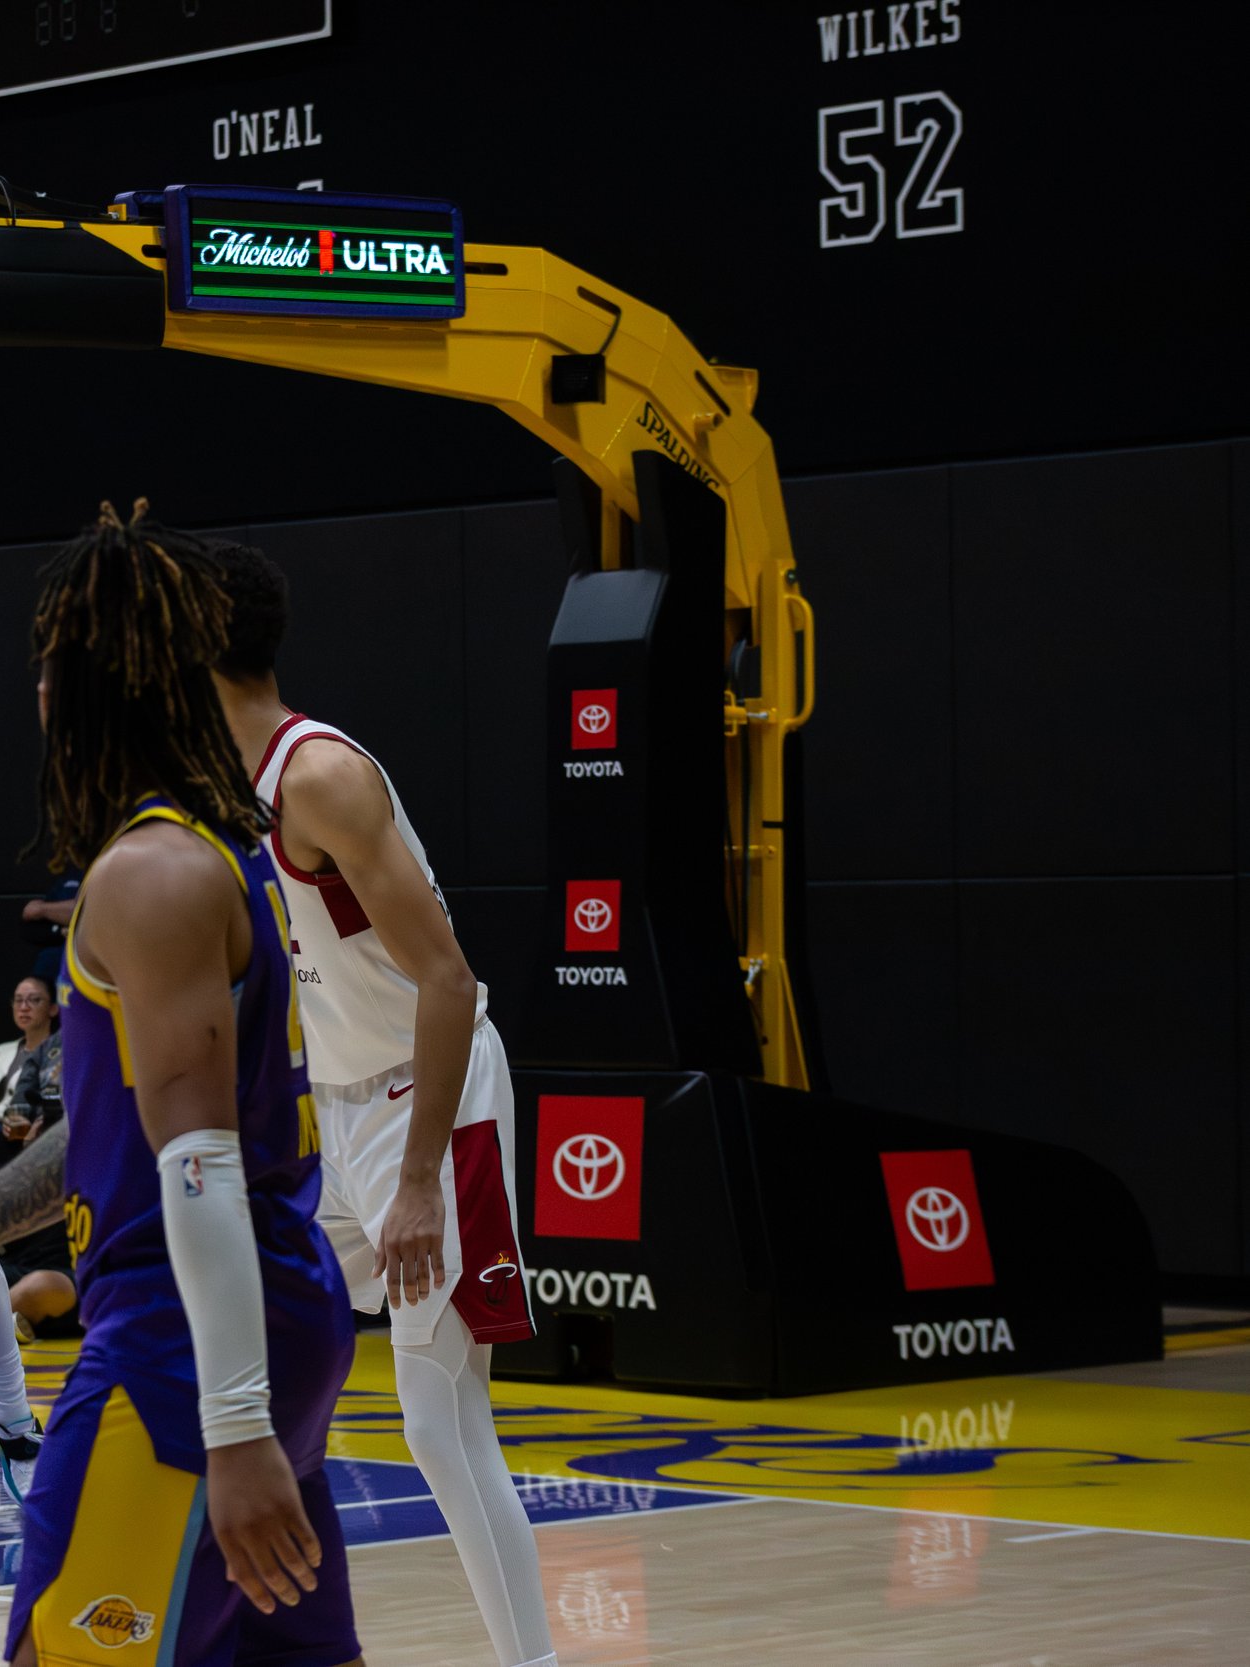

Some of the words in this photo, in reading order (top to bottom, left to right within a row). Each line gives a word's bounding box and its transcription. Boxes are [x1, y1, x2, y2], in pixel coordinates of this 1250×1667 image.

[816, 0, 962, 63] WILKES
[212, 103, 323, 161] O'NEAL
[817, 90, 965, 249] 52
[200, 227, 312, 268] Michelob
[342, 239, 450, 275] ULTRA
[563, 760, 624, 778] TOYOTA
[554, 966, 629, 987] TOYOTA
[525, 1268, 657, 1311] TOYOTA
[892, 1317, 1015, 1360] TOYOTA
